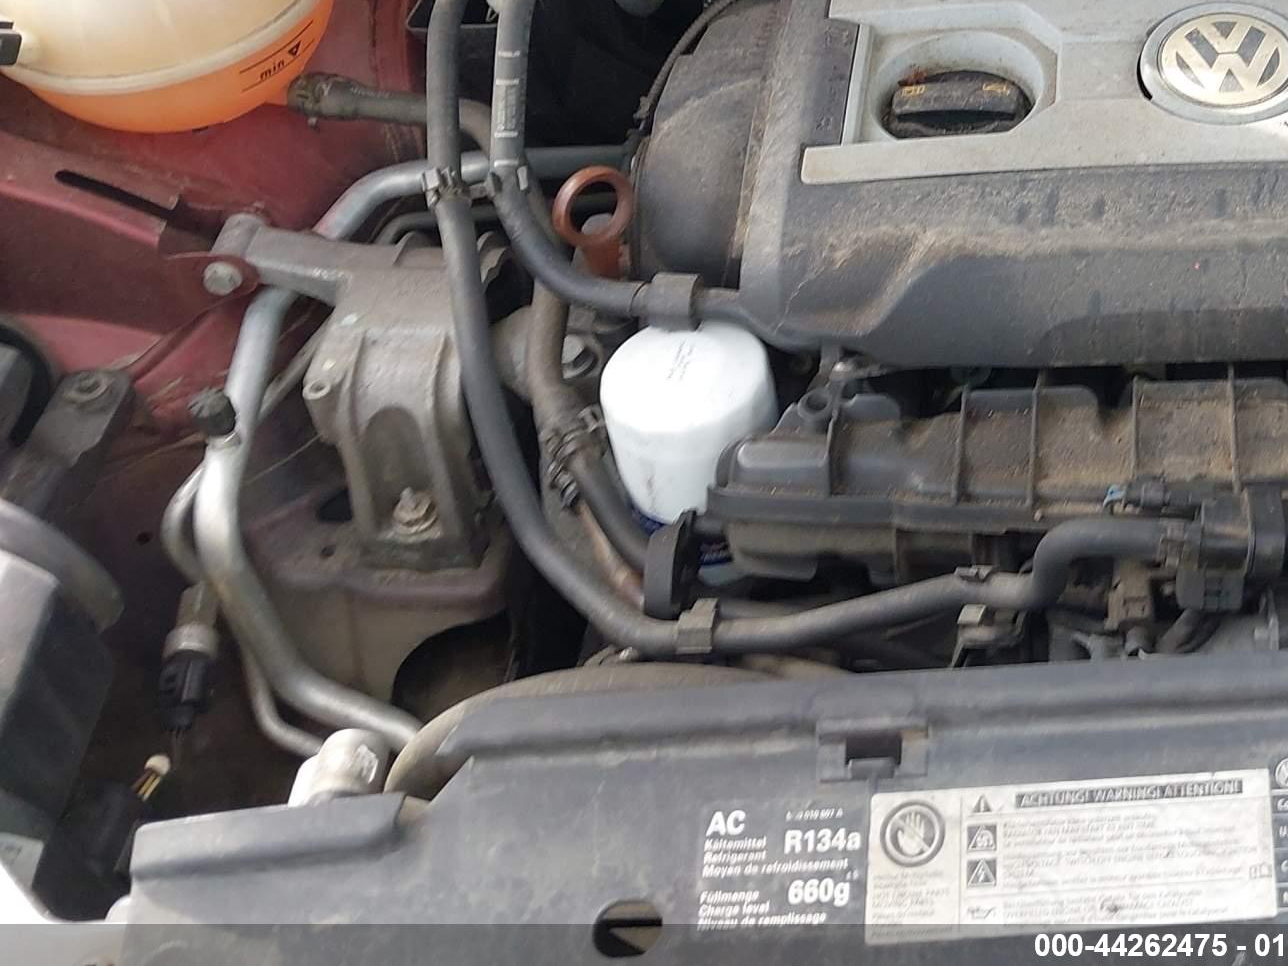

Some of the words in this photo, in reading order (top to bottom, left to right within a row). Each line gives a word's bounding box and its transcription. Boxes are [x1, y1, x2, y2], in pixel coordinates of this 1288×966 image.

[260, 59, 285, 80] min
[1020, 791, 1089, 808] ACHTUNG!
[1092, 785, 1161, 803] WARNING!
[1163, 780, 1240, 797] ATTENTION!
[705, 809, 746, 837] AC
[784, 828, 861, 855] R134a
[703, 850, 767, 865] Refrigerant
[702, 864, 741, 879] Moyen
[743, 863, 760, 876] de
[761, 858, 849, 875] refroidissement
[700, 890, 760, 905] Füllmenge
[788, 878, 850, 907] 660g
[698, 904, 740, 918] Charge
[742, 901, 770, 914] level
[697, 917, 739, 931] Niveau
[740, 916, 756, 927] de
[758, 912, 827, 927] remplissage
